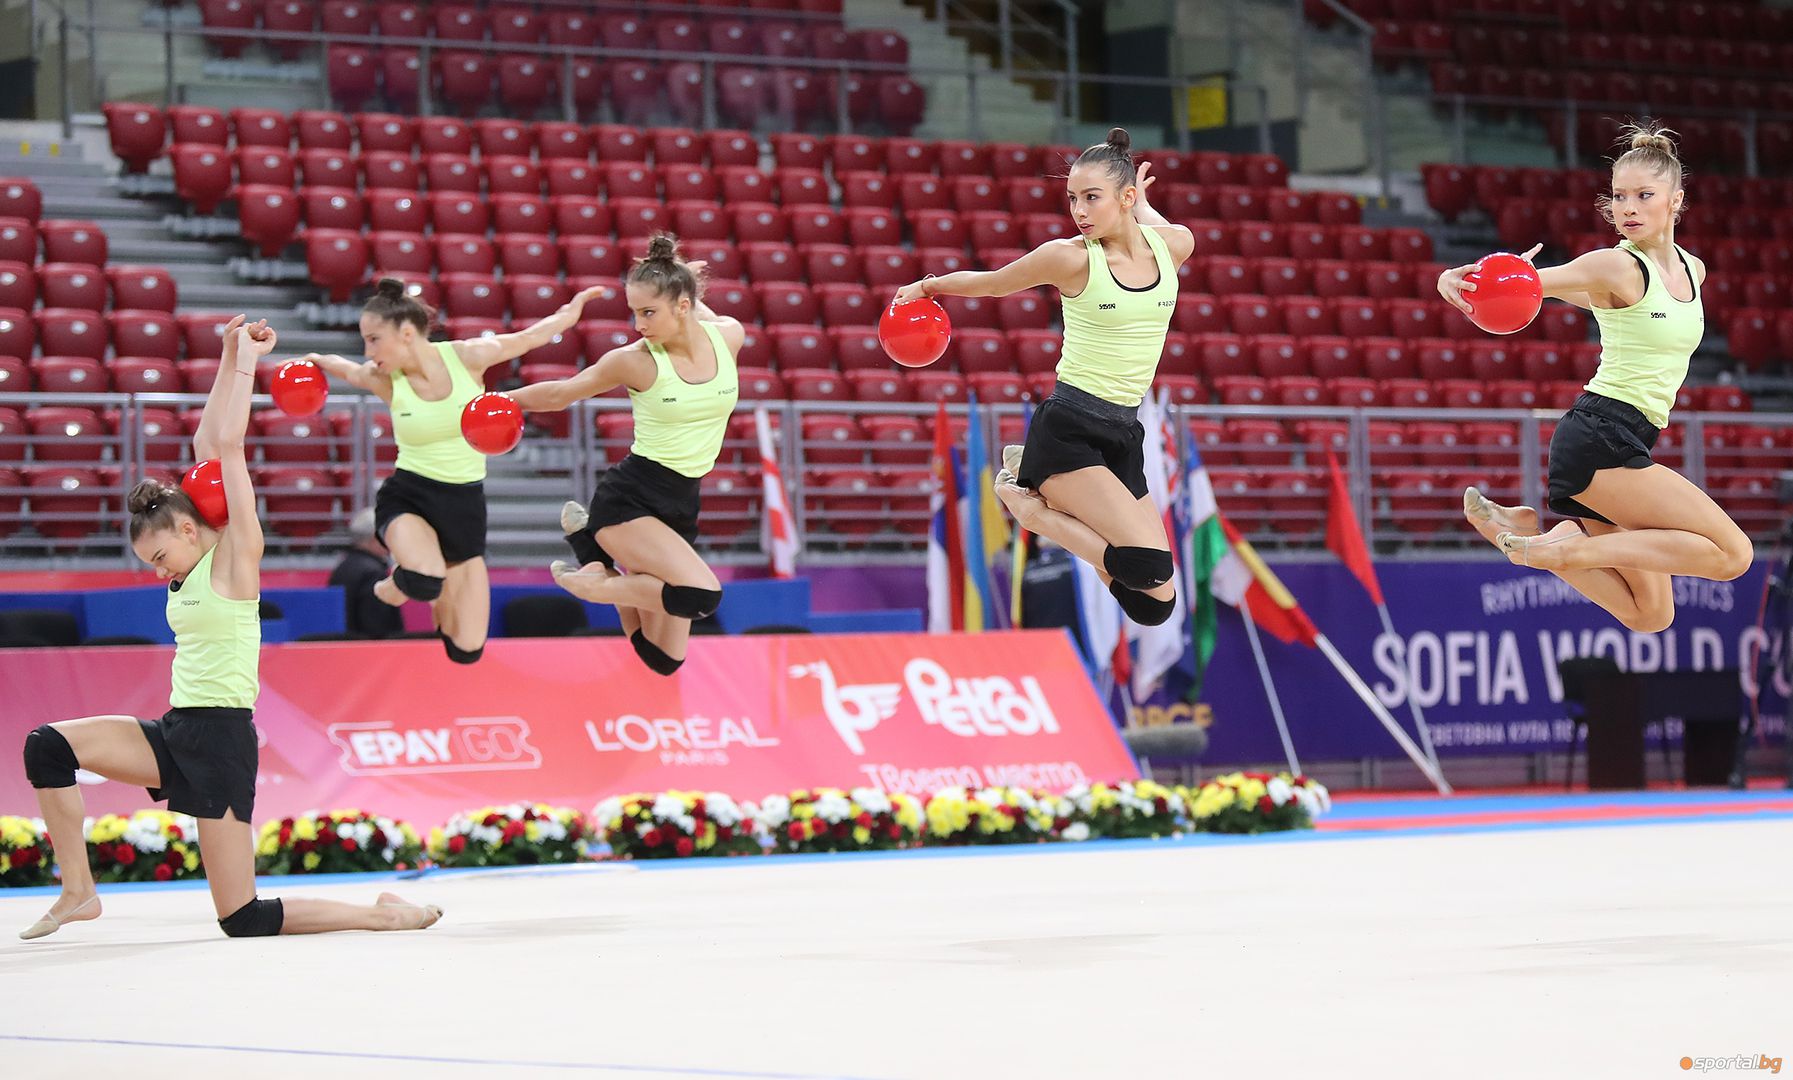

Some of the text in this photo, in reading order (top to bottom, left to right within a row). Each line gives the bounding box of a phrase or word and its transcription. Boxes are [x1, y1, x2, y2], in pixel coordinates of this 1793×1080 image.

[904, 658, 1060, 736] Petrol
[1373, 630, 1529, 709] SOFIA
[349, 726, 523, 766] EPAY GO
[659, 751, 730, 766] PARIS
